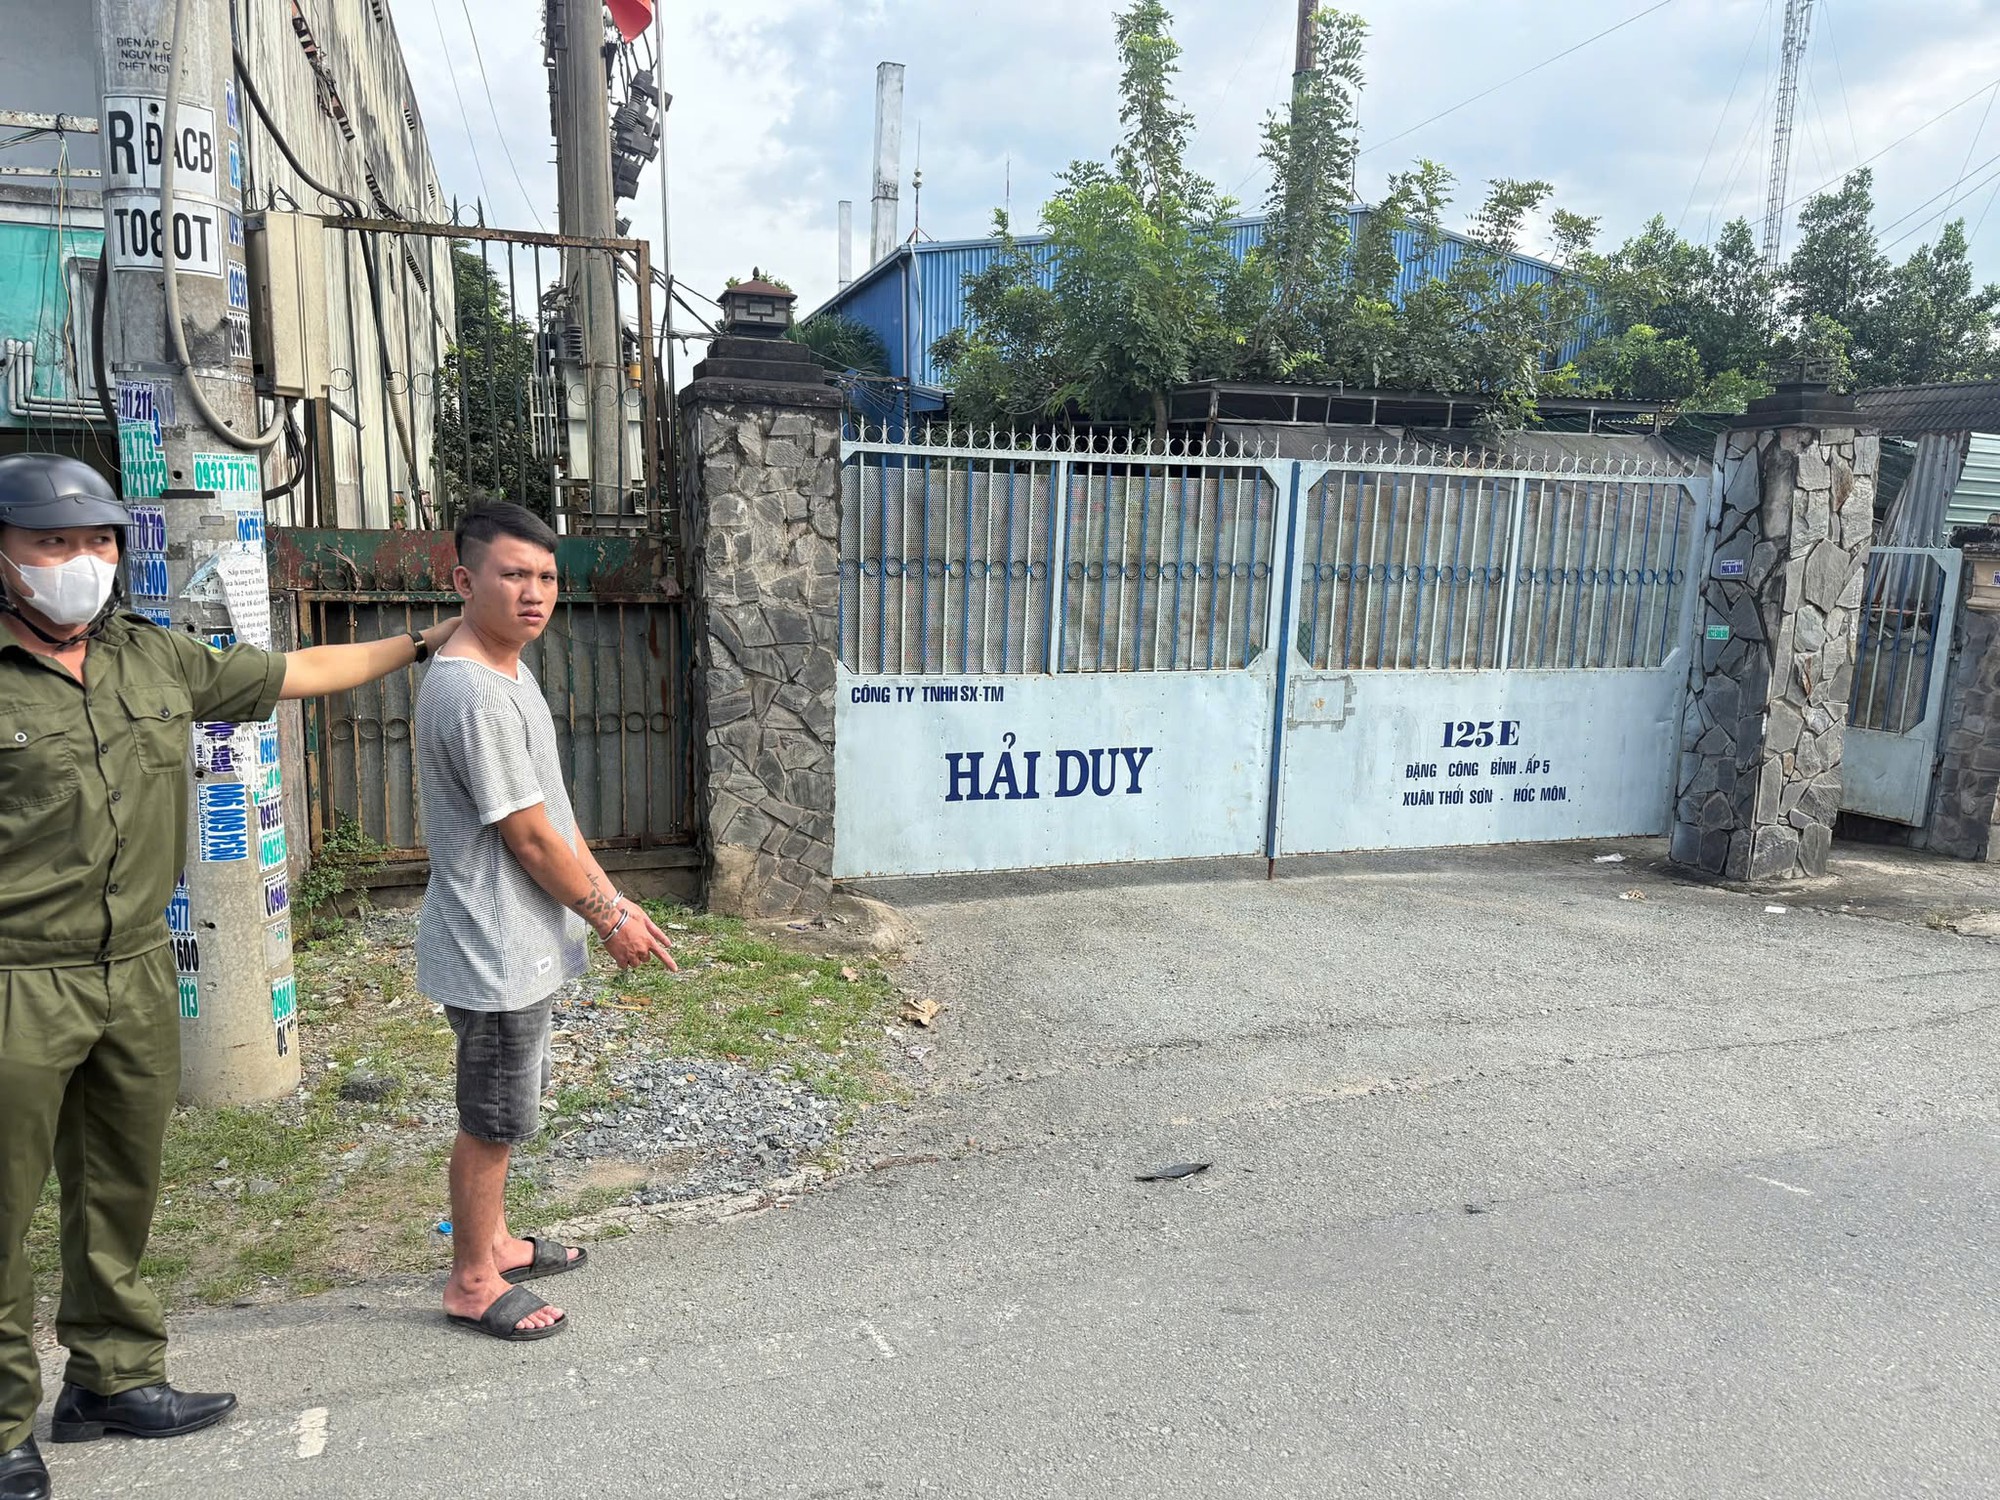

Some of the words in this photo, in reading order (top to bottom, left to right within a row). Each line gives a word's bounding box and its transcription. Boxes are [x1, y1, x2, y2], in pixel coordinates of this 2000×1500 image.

[108, 110, 137, 174] R
[852, 684, 890, 703] CÔNG
[896, 687, 915, 702] TY
[922, 686, 958, 702] TNHH
[945, 732, 1040, 801] HẢI
[1055, 747, 1153, 797] DUY
[1405, 763, 1436, 781] ĐẶNG
[1448, 761, 1478, 777] CÔNG
[1525, 754, 1540, 774] ẤP
[1542, 760, 1550, 774] 5
[1403, 790, 1434, 806] XUÂN
[1438, 784, 1463, 805] THỚI
[1469, 788, 1492, 804] SƠN
[1513, 783, 1535, 803] HÓC
